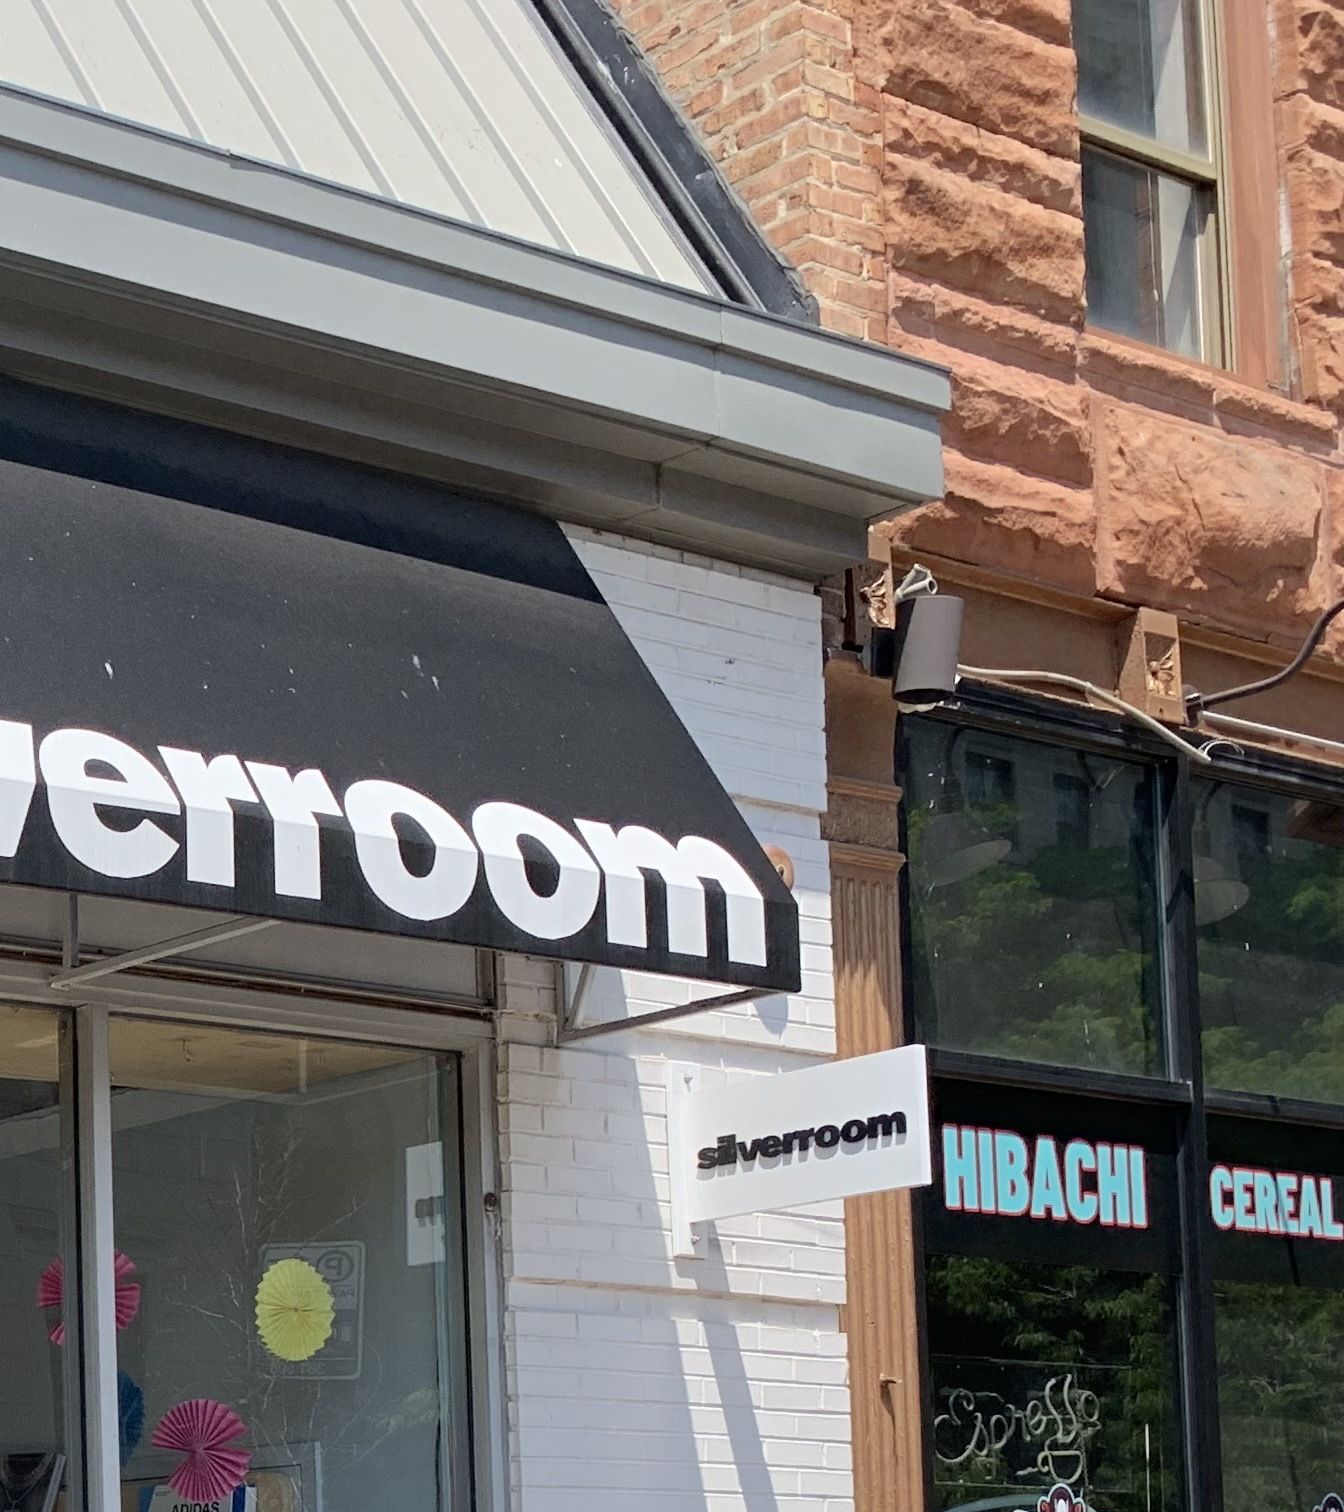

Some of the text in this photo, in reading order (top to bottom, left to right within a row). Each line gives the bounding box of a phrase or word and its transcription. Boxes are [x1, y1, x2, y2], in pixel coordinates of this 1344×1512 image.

[696, 1107, 907, 1172] silverroom
[942, 1123, 1148, 1230] HIBACHI
[1209, 1164, 1344, 1241] CEREAL
